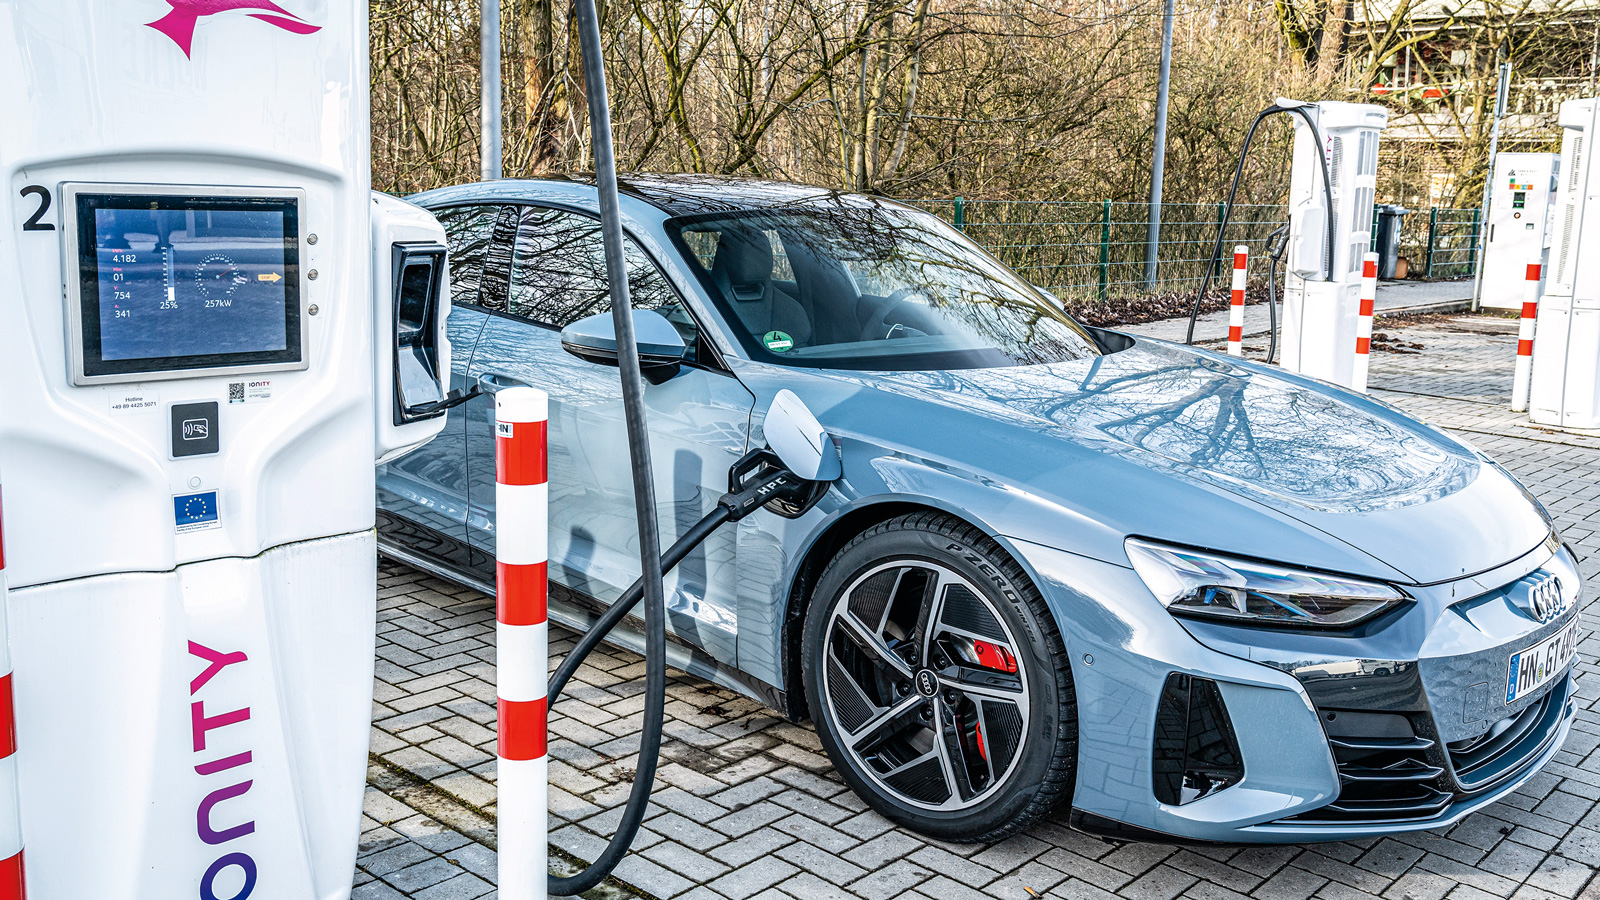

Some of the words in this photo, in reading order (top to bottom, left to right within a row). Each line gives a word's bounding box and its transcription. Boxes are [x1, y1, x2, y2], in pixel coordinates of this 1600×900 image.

[19, 184, 56, 231] 2
[112, 254, 137, 263] 4.182
[113, 273, 124, 281] 01
[114, 291, 131, 300] 754
[159, 301, 179, 310] 25%
[204, 299, 232, 308] 257kW
[115, 309, 131, 319] 341
[773, 331, 782, 341] 4
[757, 477, 787, 495] HPC
[945, 542, 963, 552] P
[963, 552, 1021, 604] ZERO
[1517, 650, 1539, 693] HN
[1545, 637, 1561, 677] GT
[187, 639, 258, 900] ONITY
